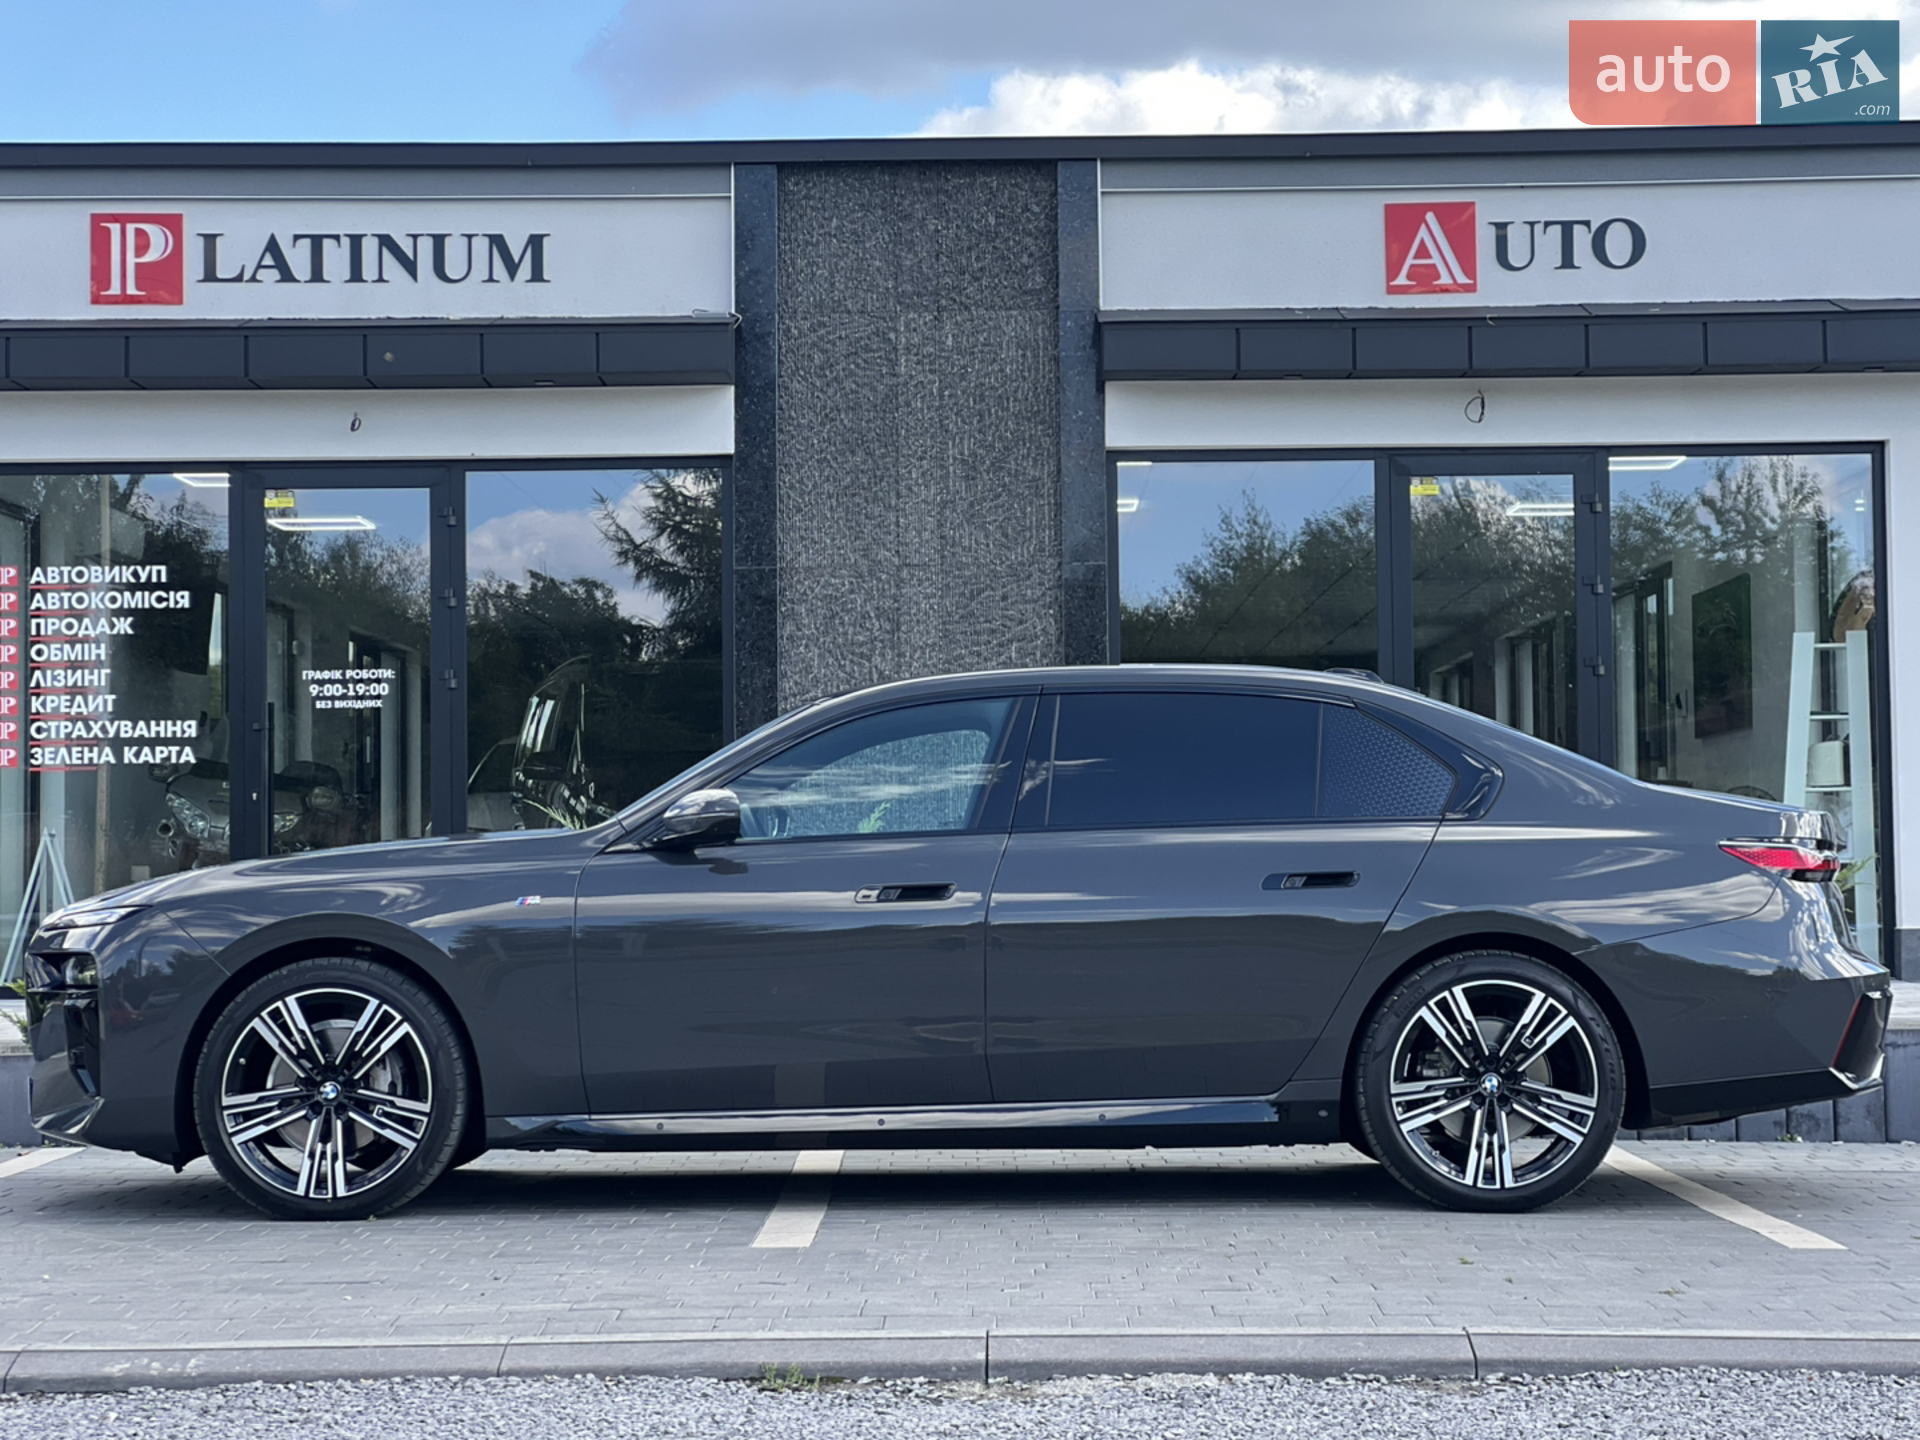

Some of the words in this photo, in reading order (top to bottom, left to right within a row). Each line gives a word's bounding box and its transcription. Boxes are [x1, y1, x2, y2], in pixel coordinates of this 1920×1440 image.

[30, 565, 167, 584] АВТОВИКУП
[30, 591, 191, 610] АВТОКОМІСІЯ
[30, 617, 135, 638] ПРОДАЖ
[30, 643, 106, 662] ОБМІН
[30, 669, 112, 688] ЛІЗИНГ
[302, 670, 343, 680] ГРАФІК
[345, 669, 396, 679] РОБОТИ:
[309, 683, 389, 697] 9:00-19:00
[30, 694, 117, 715] КРЕДИТ
[315, 700, 332, 709] БЕЗ
[334, 700, 383, 709] ВИХІДНИХ
[30, 720, 197, 739] СТРАХУВАННЯ
[30, 747, 116, 765] ЗЕЛЕНА
[123, 746, 196, 764] КАРТА
